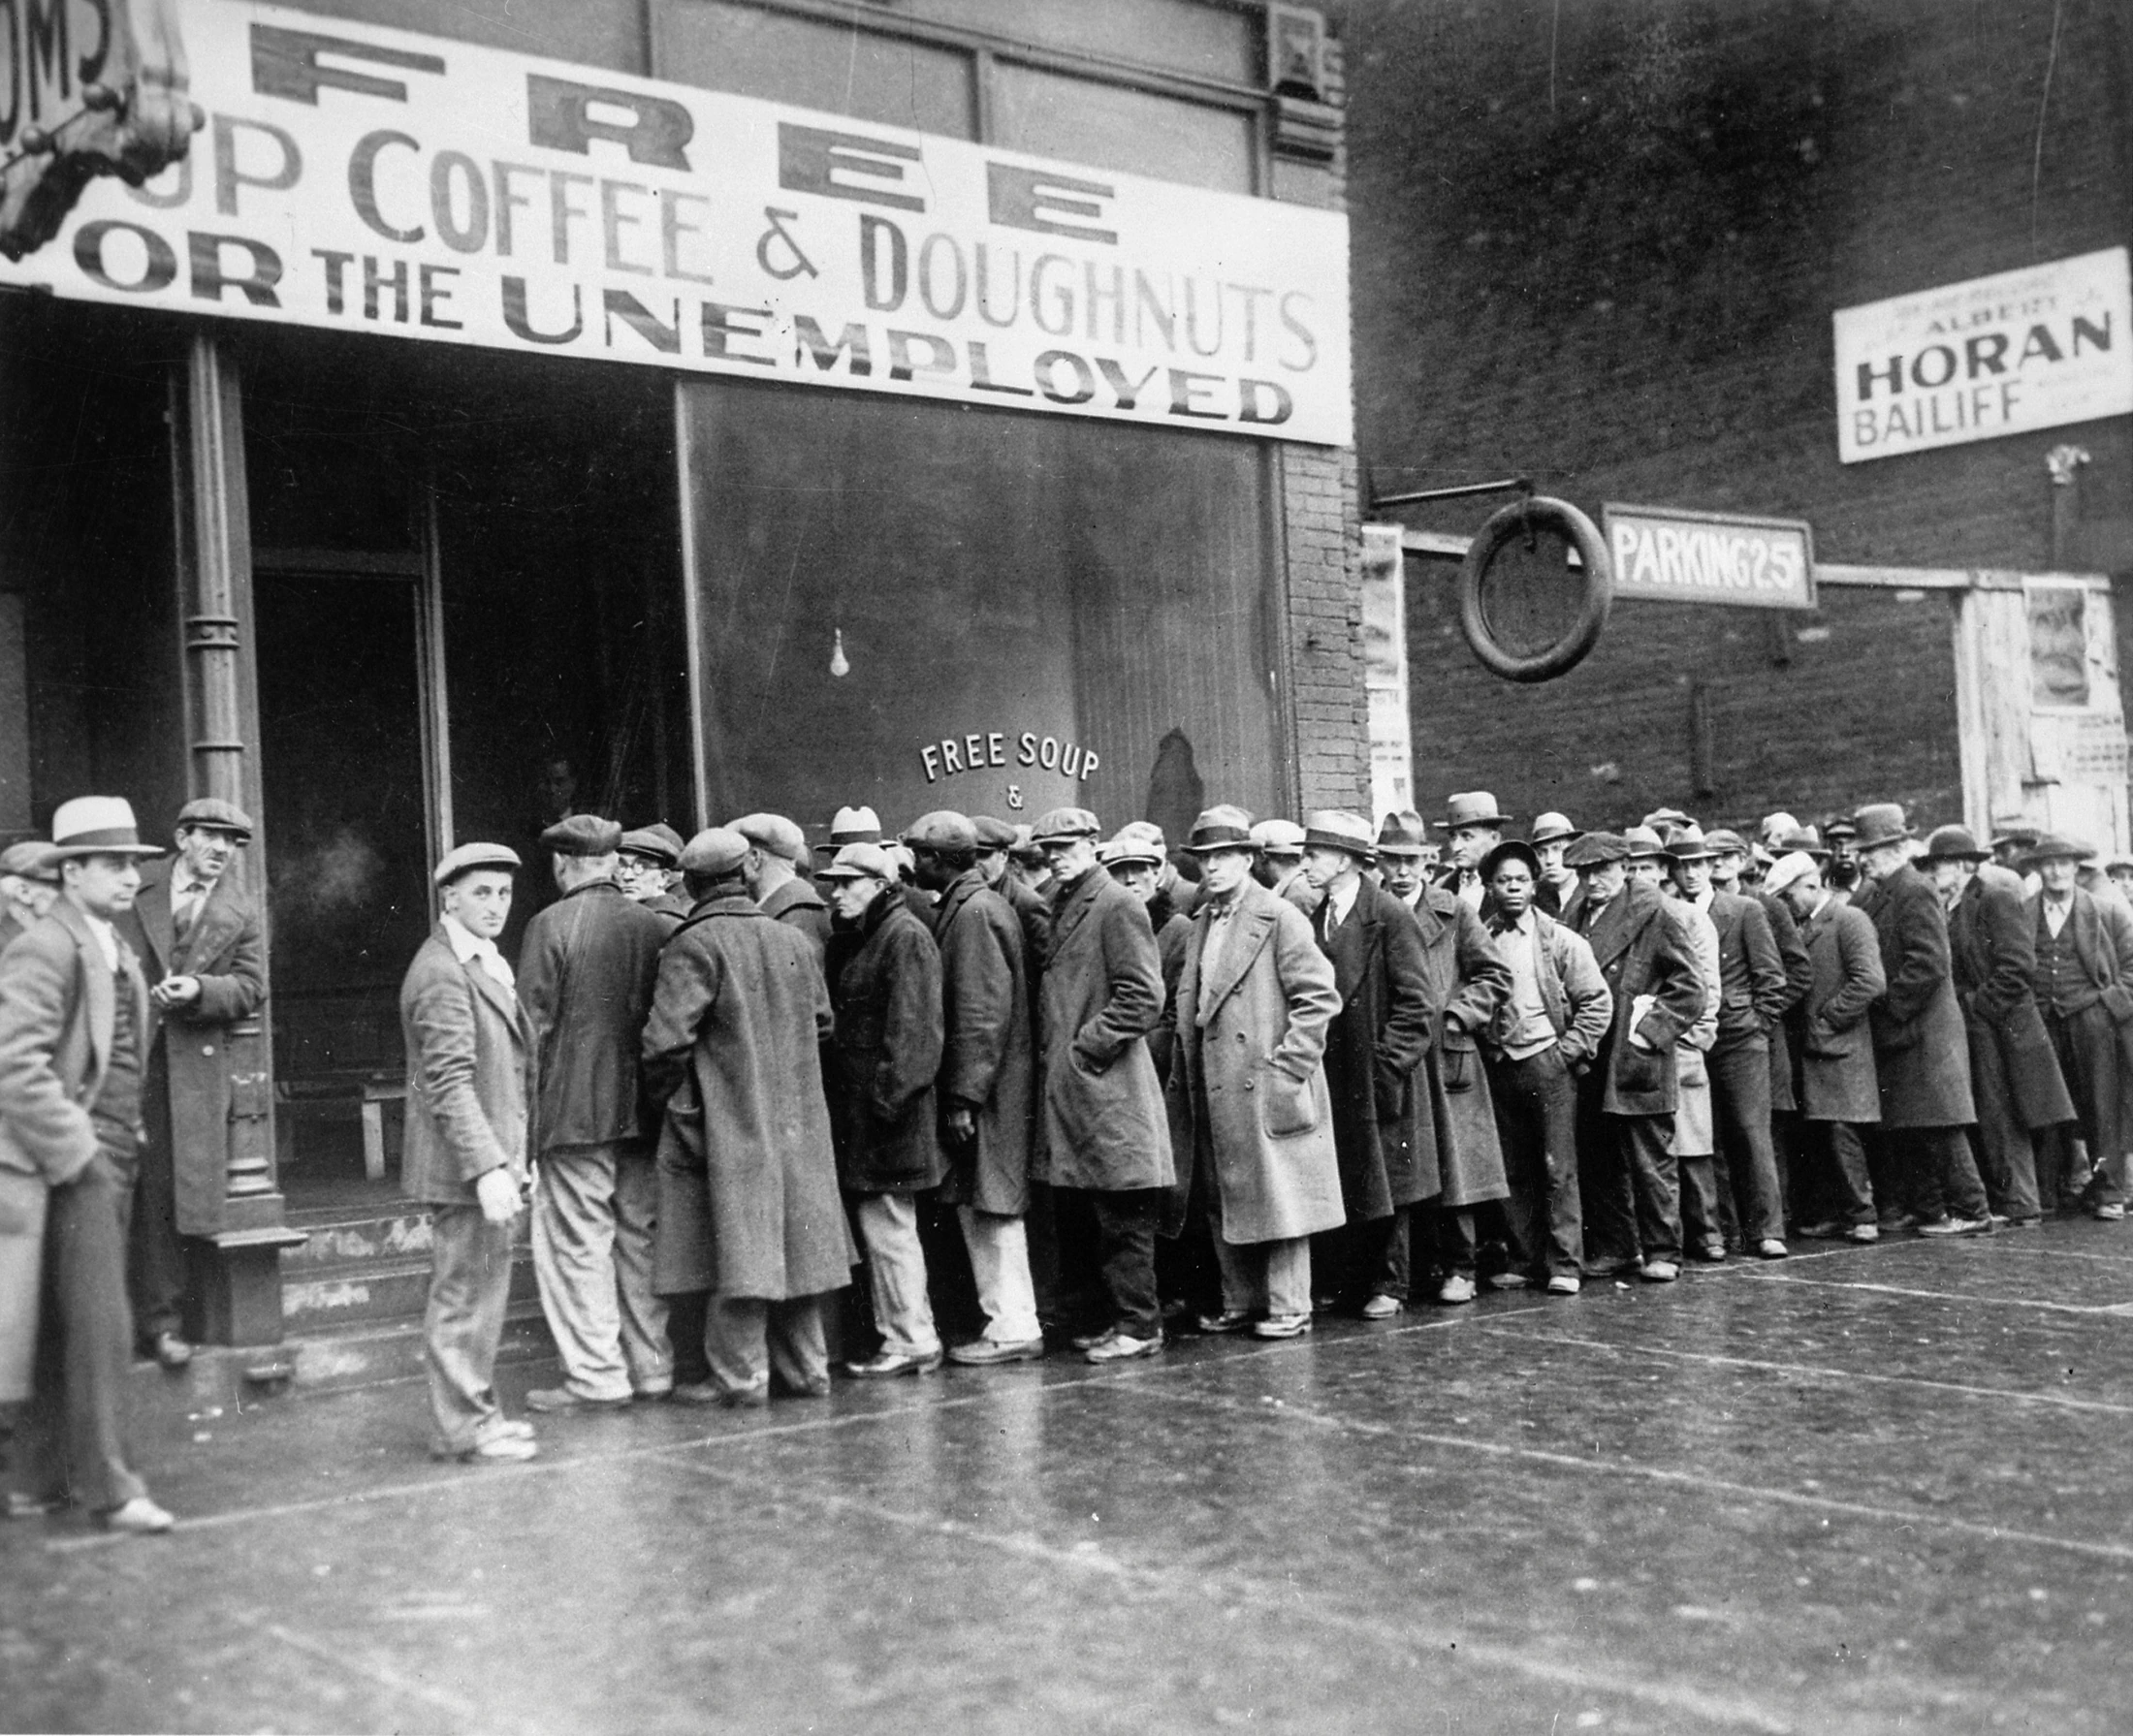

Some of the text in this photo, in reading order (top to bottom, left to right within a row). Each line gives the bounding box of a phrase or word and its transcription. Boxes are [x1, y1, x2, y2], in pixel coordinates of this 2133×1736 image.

[249, 21, 1119, 245] FREE
[347, 128, 715, 285] COFFEE
[756, 205, 819, 280] &
[859, 212, 1319, 372] DOUGHNUTS
[310, 248, 464, 331] THE
[500, 274, 1293, 426] UNEMPLOYED
[1856, 309, 2113, 402] HORAN
[1853, 378, 2023, 448] BAILIFF
[920, 731, 1100, 783] FREE SOUP
[1006, 784, 1024, 809] &
